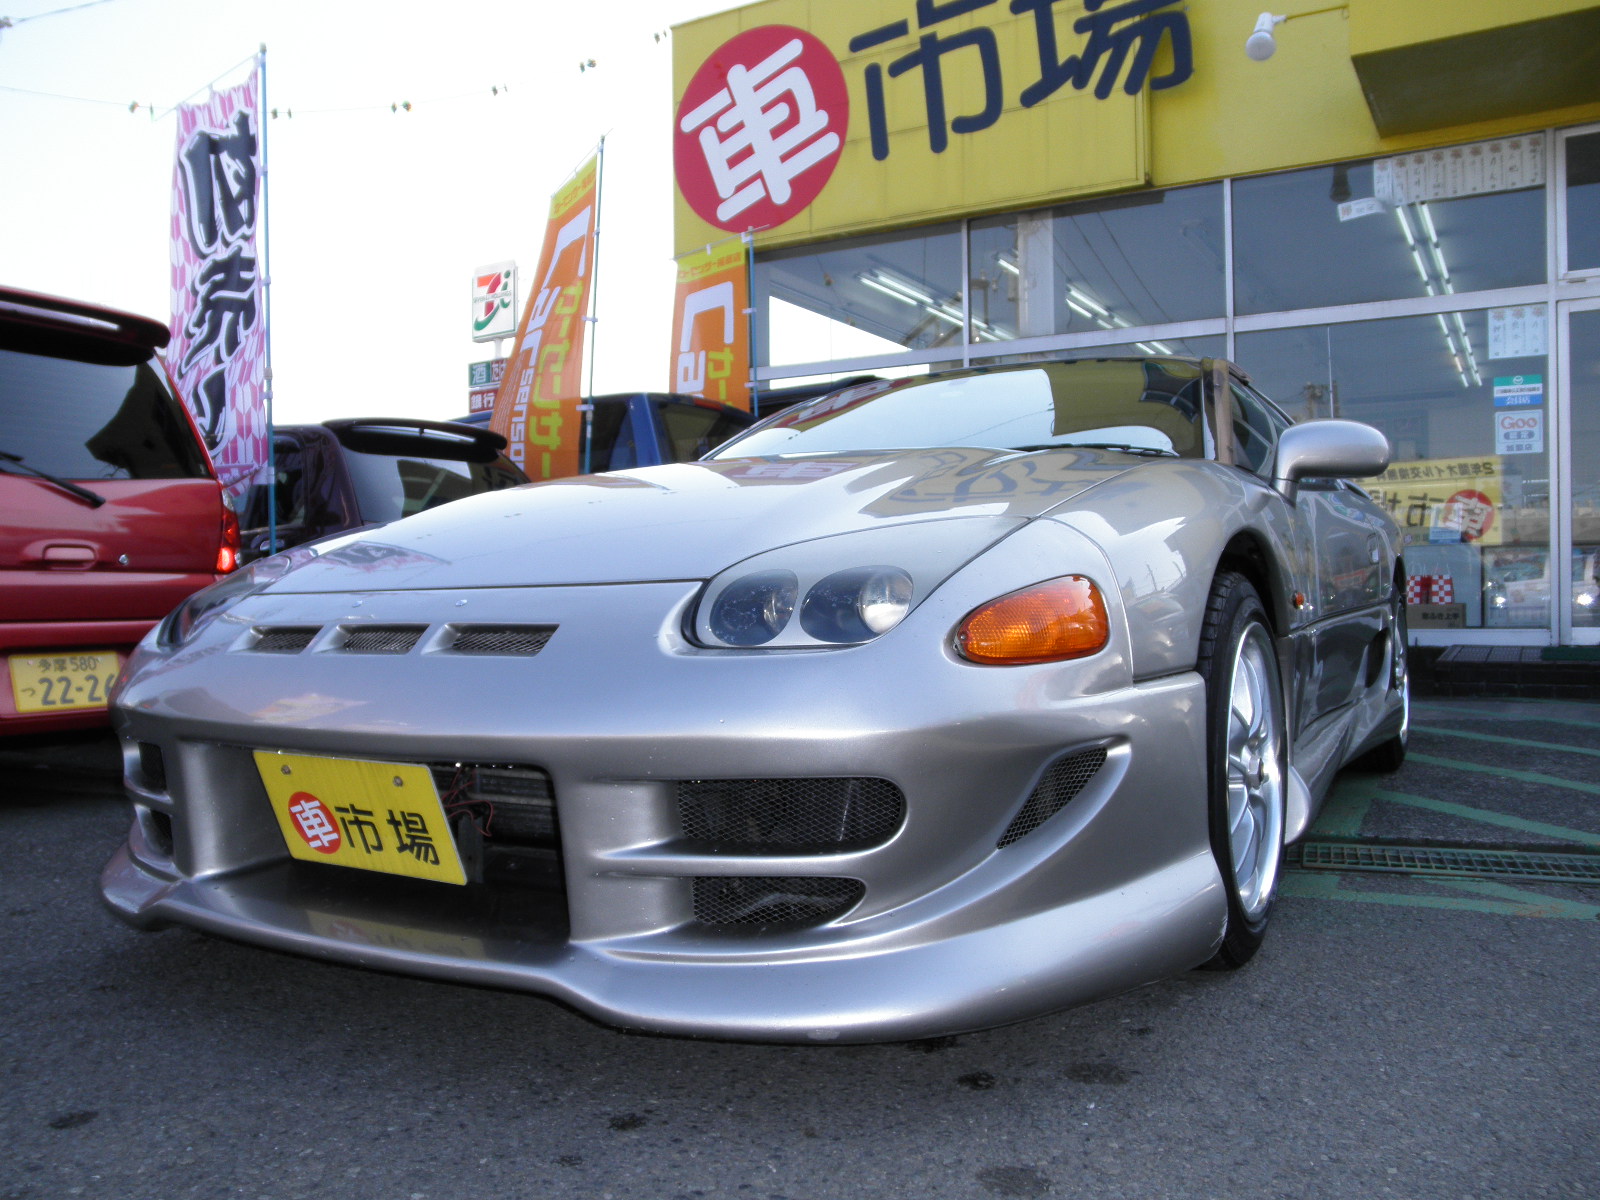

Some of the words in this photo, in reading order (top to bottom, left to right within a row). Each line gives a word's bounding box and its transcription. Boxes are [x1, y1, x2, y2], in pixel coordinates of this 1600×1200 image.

[676, 280, 734, 399] ca
[472, 364, 486, 385] 酒
[529, 280, 583, 478] カーセンサー
[707, 346, 734, 406] カー
[470, 391, 496, 411] 銀行
[1501, 415, 1538, 430] Goo
[21, 687, 36, 697] つ
[289, 799, 441, 866] 車市場
